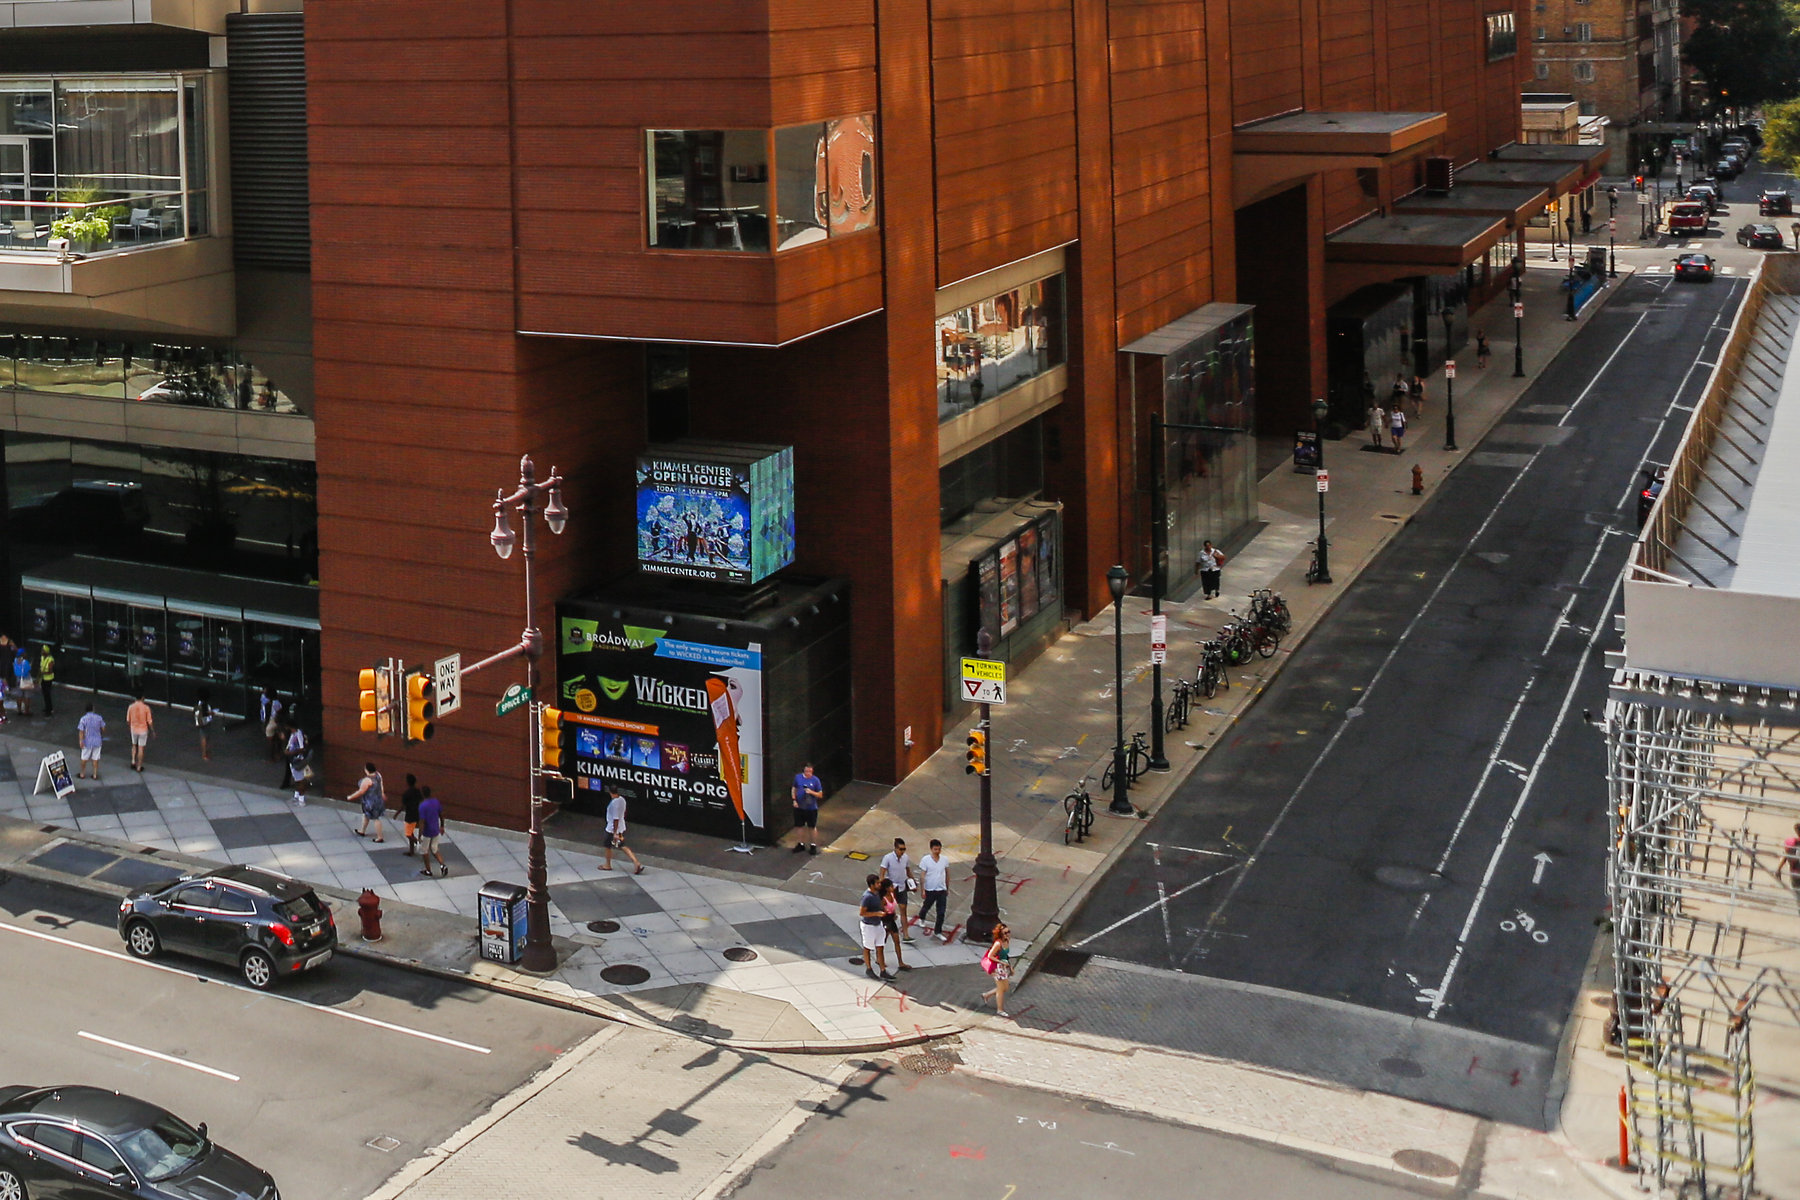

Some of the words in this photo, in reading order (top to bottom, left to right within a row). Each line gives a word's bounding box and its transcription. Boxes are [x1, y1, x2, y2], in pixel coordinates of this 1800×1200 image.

[653, 461, 691, 473] KIMMEL
[694, 465, 731, 477] CENTER
[653, 471, 686, 483] OPEN
[690, 475, 731, 487] HOUSE
[642, 563, 717, 579] KIMMELCENTER.ORG
[586, 630, 645, 649] BROADWAY
[664, 641, 674, 649] The
[675, 643, 688, 651] only
[731, 651, 750, 659] tickets
[676, 650, 701, 660] WICKED
[440, 661, 455, 677] ONE
[976, 662, 1002, 671] TURNING
[976, 671, 1003, 679] VEHICLES
[440, 676, 455, 692] WAY
[501, 696, 520, 712] SPRUCE
[577, 761, 728, 798] KIMMELCENTER.ORG
